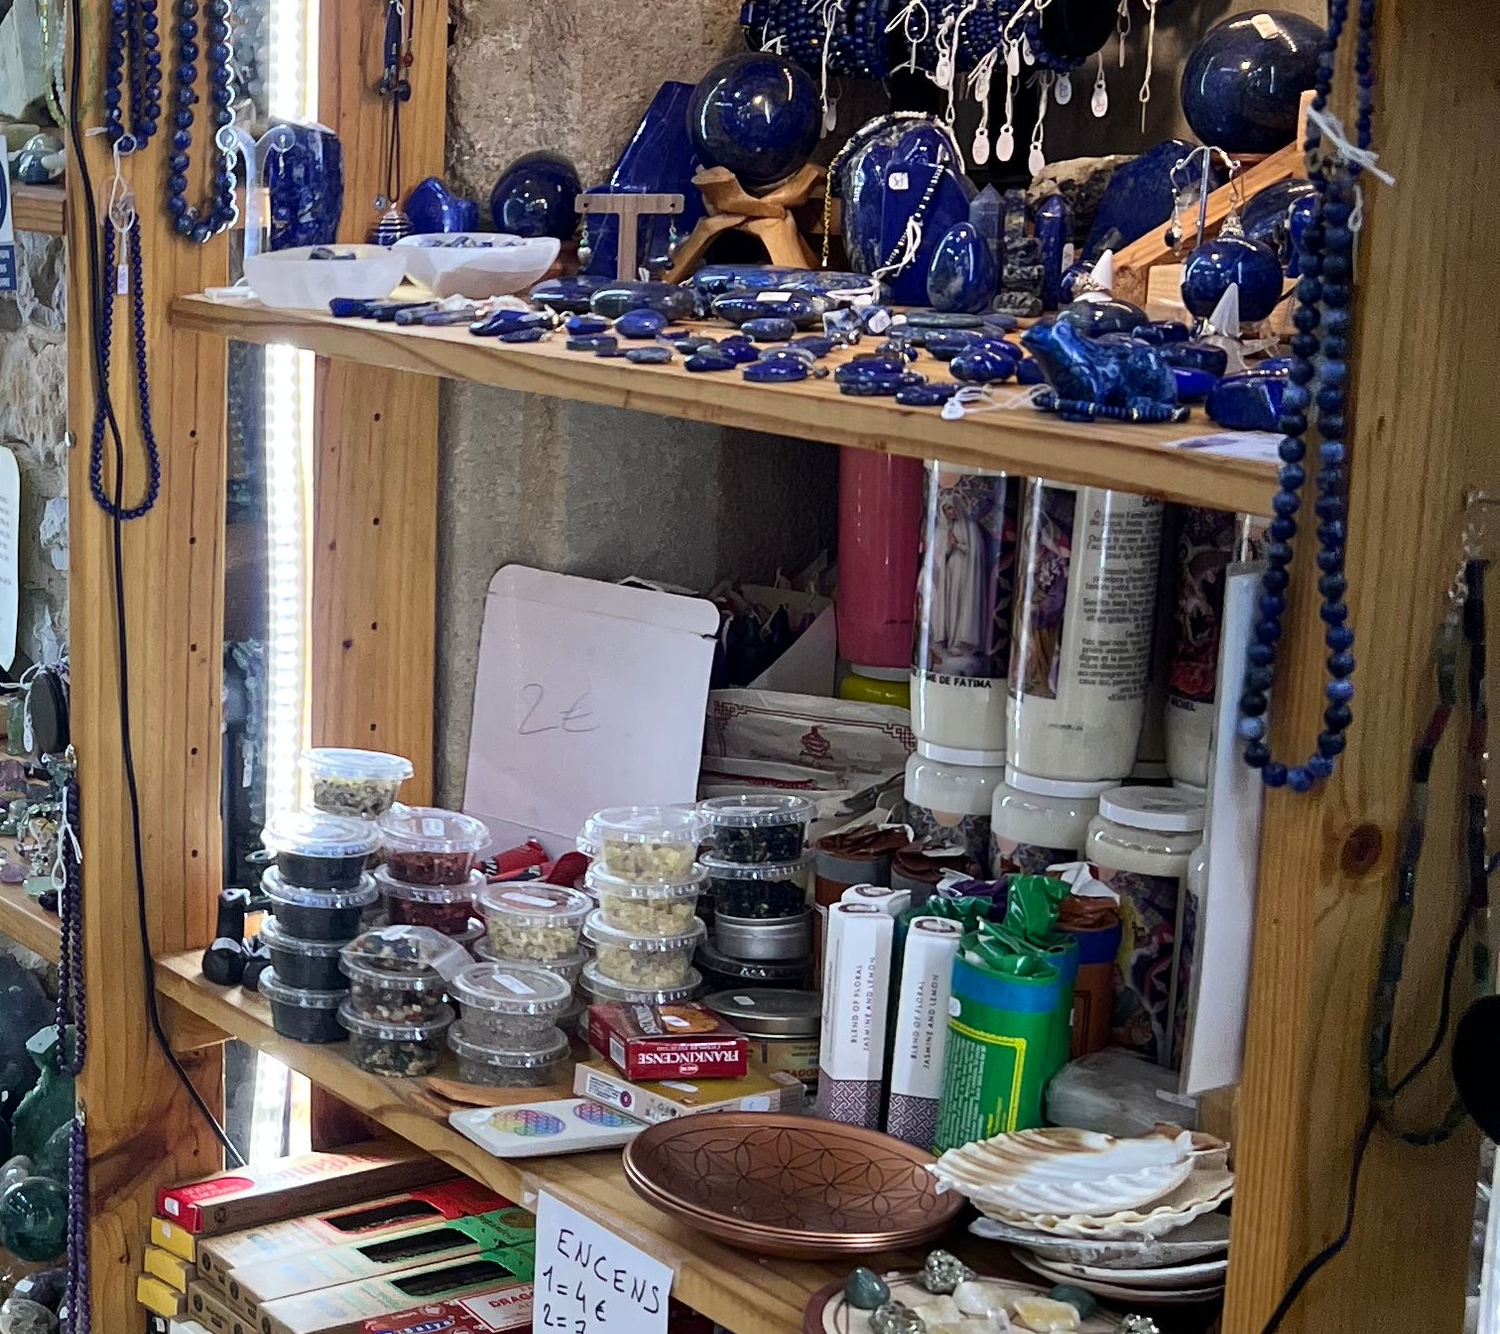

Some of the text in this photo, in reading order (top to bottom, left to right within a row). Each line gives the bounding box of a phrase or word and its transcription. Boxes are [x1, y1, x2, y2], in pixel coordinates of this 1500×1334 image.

[939, 676, 992, 688] DE FATIMA
[851, 964, 863, 1044] BLEND OF FLORAL
[910, 980, 925, 1060] BLEND OF FLORAL
[924, 974, 940, 1069] JASMINE AND LEMON
[638, 1050, 739, 1065] FRANKINCENSE
[556, 1228, 661, 1314] ENCENS
